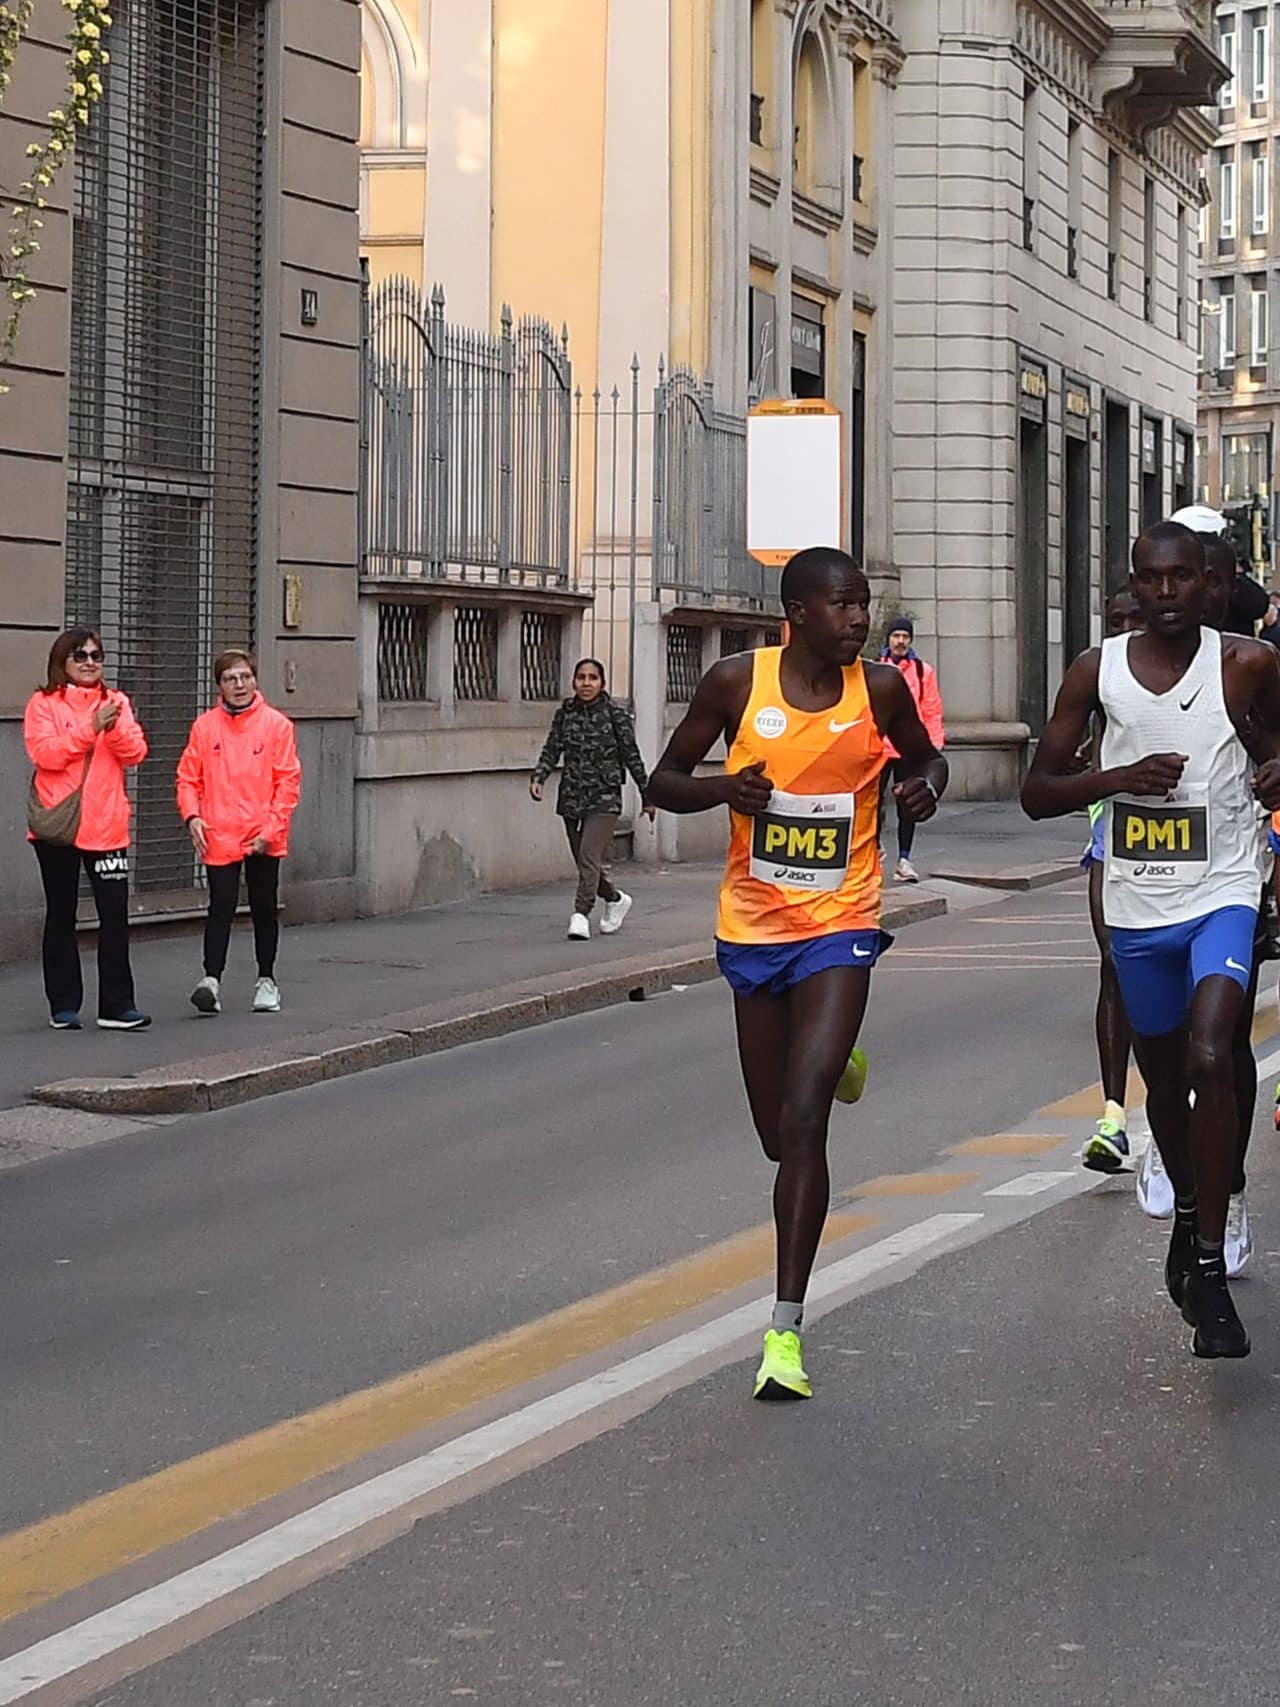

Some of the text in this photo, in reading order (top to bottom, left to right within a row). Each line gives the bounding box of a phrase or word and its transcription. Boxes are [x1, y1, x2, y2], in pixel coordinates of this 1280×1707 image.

[765, 823, 838, 860] PM3
[1126, 816, 1190, 850] PM1
[787, 870, 816, 881] asics
[1147, 865, 1176, 875] asics
